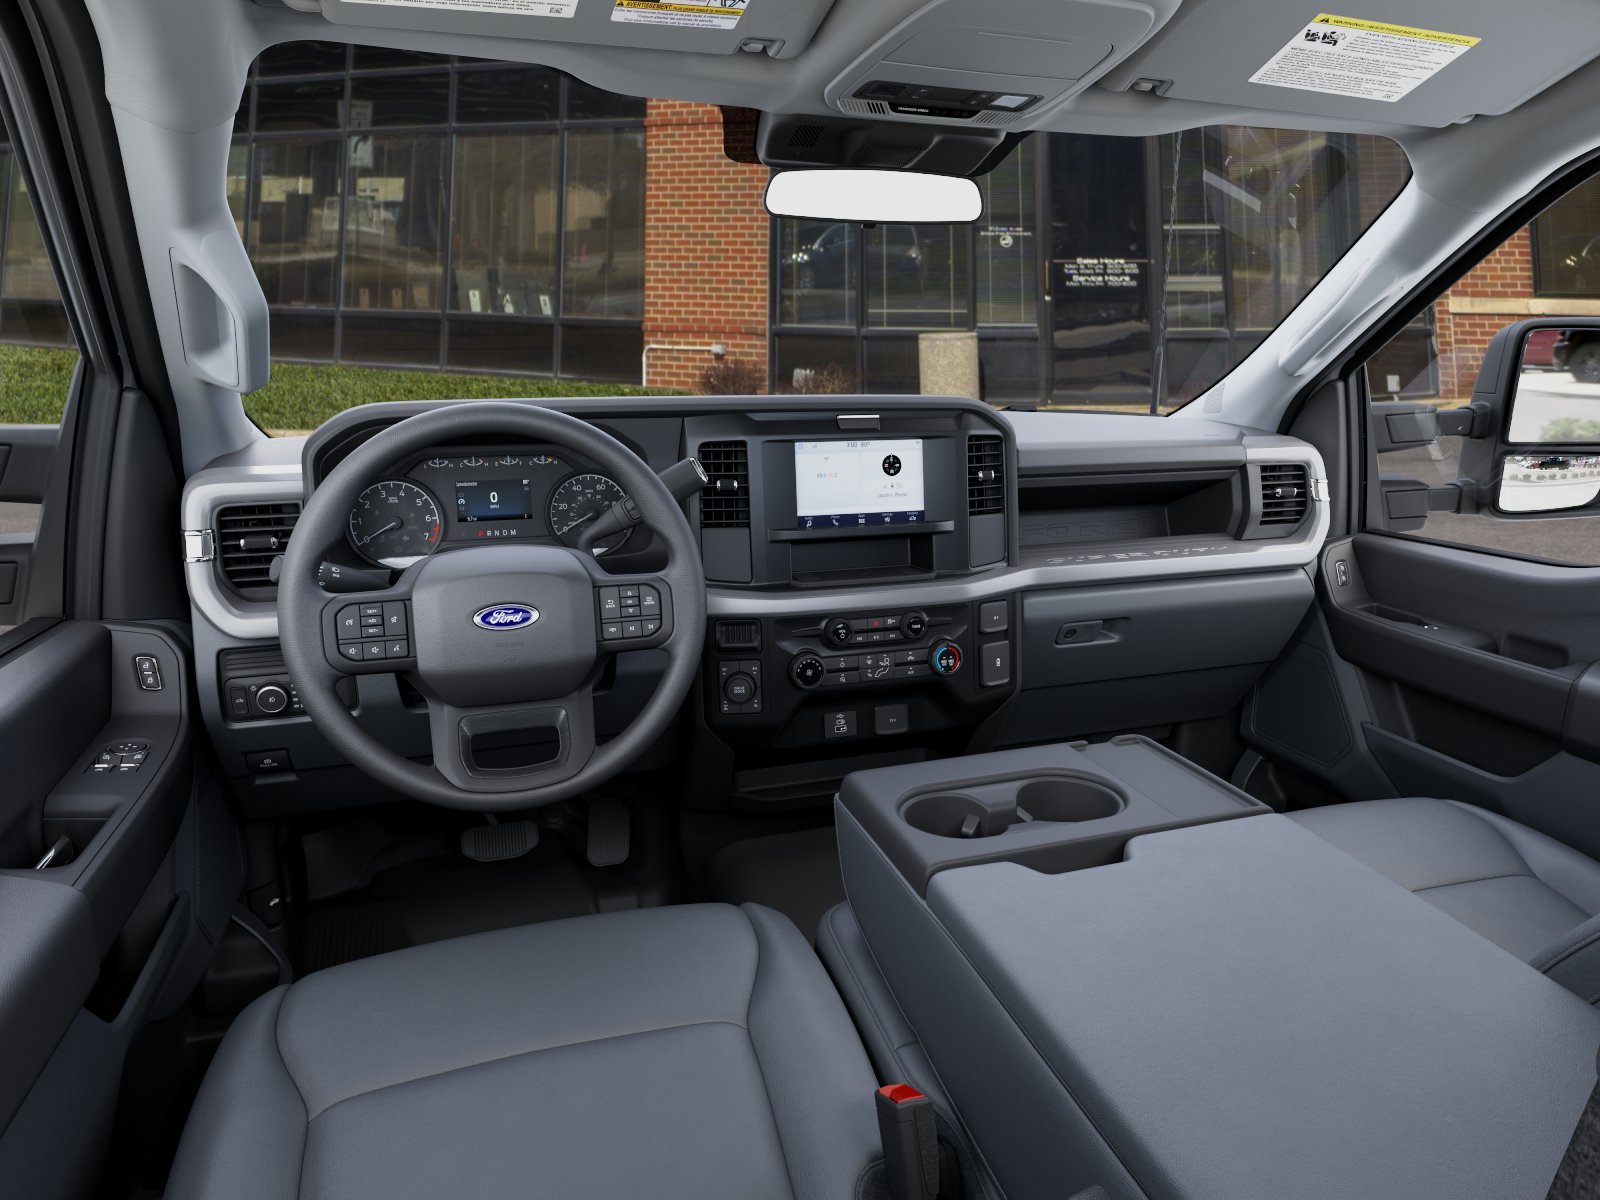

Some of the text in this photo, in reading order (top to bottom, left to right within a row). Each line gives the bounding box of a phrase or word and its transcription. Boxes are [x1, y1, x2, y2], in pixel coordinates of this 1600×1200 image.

[1072, 274, 1130, 282] Service Hours
[380, 490, 386, 498] 3
[490, 491, 498, 503] 0
[364, 501, 371, 509] 2
[416, 498, 422, 506] 5
[425, 514, 432, 522] 6
[363, 535, 370, 543] 0
[423, 532, 430, 540] 7
[489, 609, 523, 624] Ford
